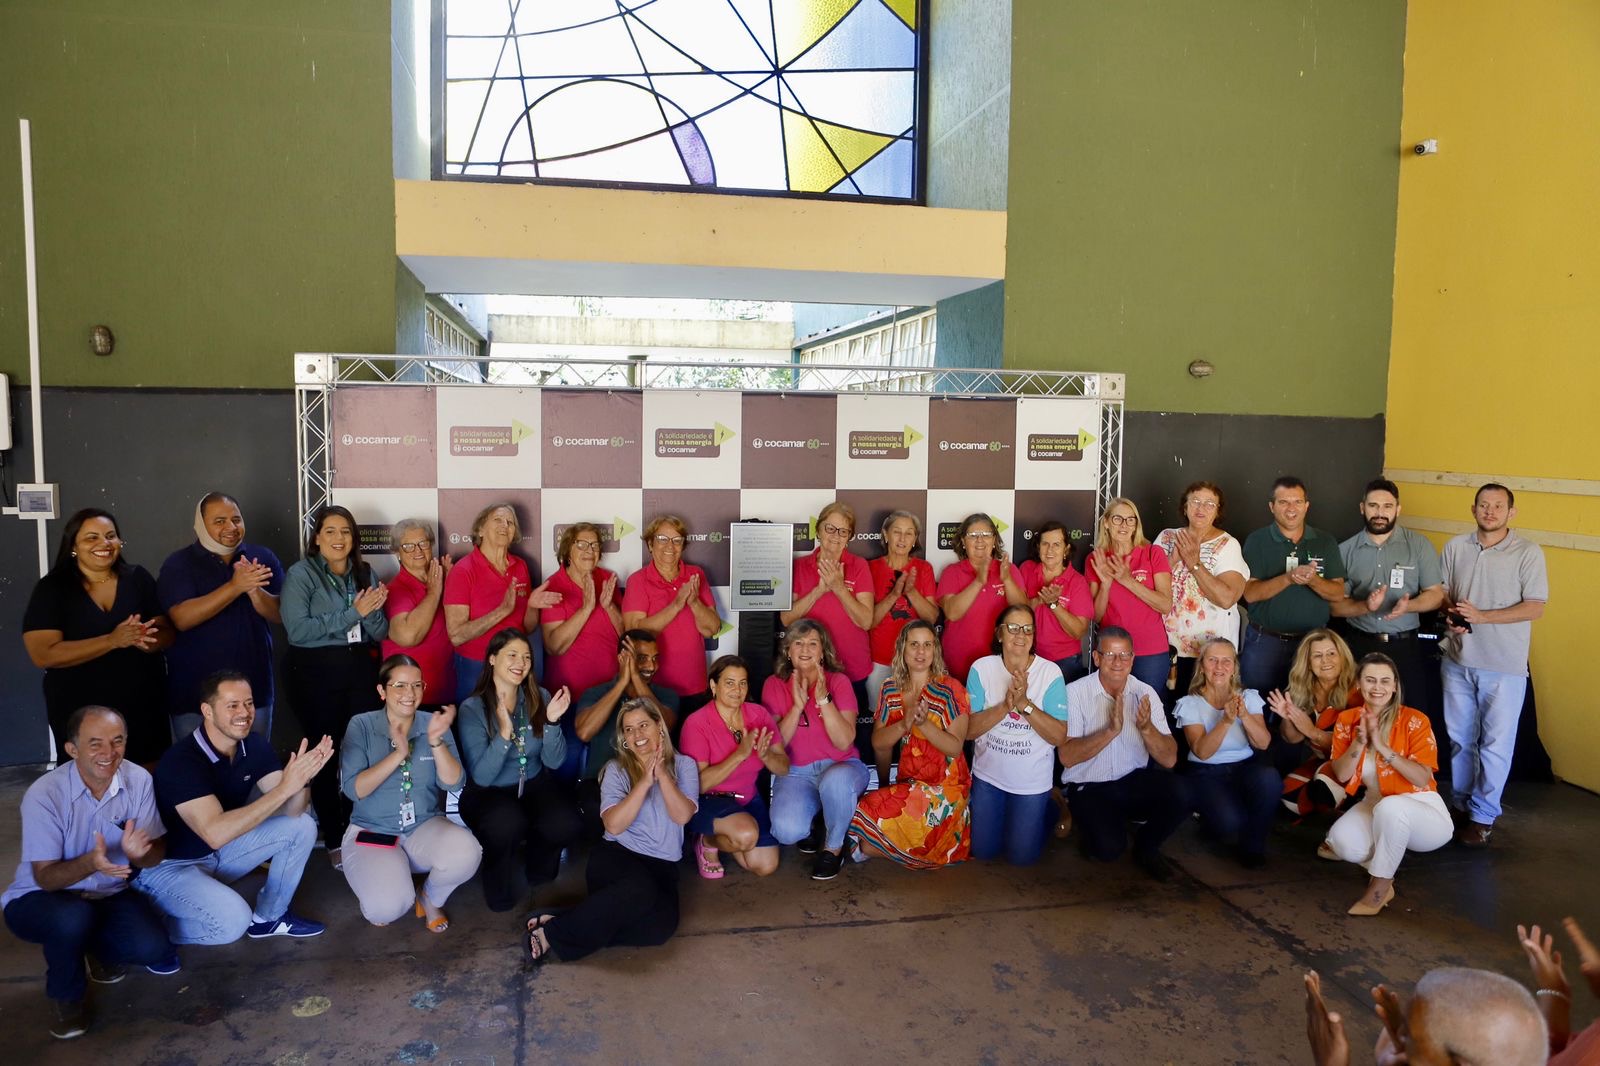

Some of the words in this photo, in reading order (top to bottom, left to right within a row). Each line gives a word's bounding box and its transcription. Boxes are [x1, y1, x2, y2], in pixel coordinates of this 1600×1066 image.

[355, 435, 401, 444] cocamar
[403, 435, 417, 446] 60
[565, 437, 608, 446] cocamar
[610, 436, 624, 447] 60
[764, 439, 805, 448] cocamar
[807, 439, 819, 449] 60
[950, 441, 988, 450] cocamar
[989, 441, 1001, 451] 60
[709, 531, 722, 542] 60
[1071, 530, 1082, 540] 60
